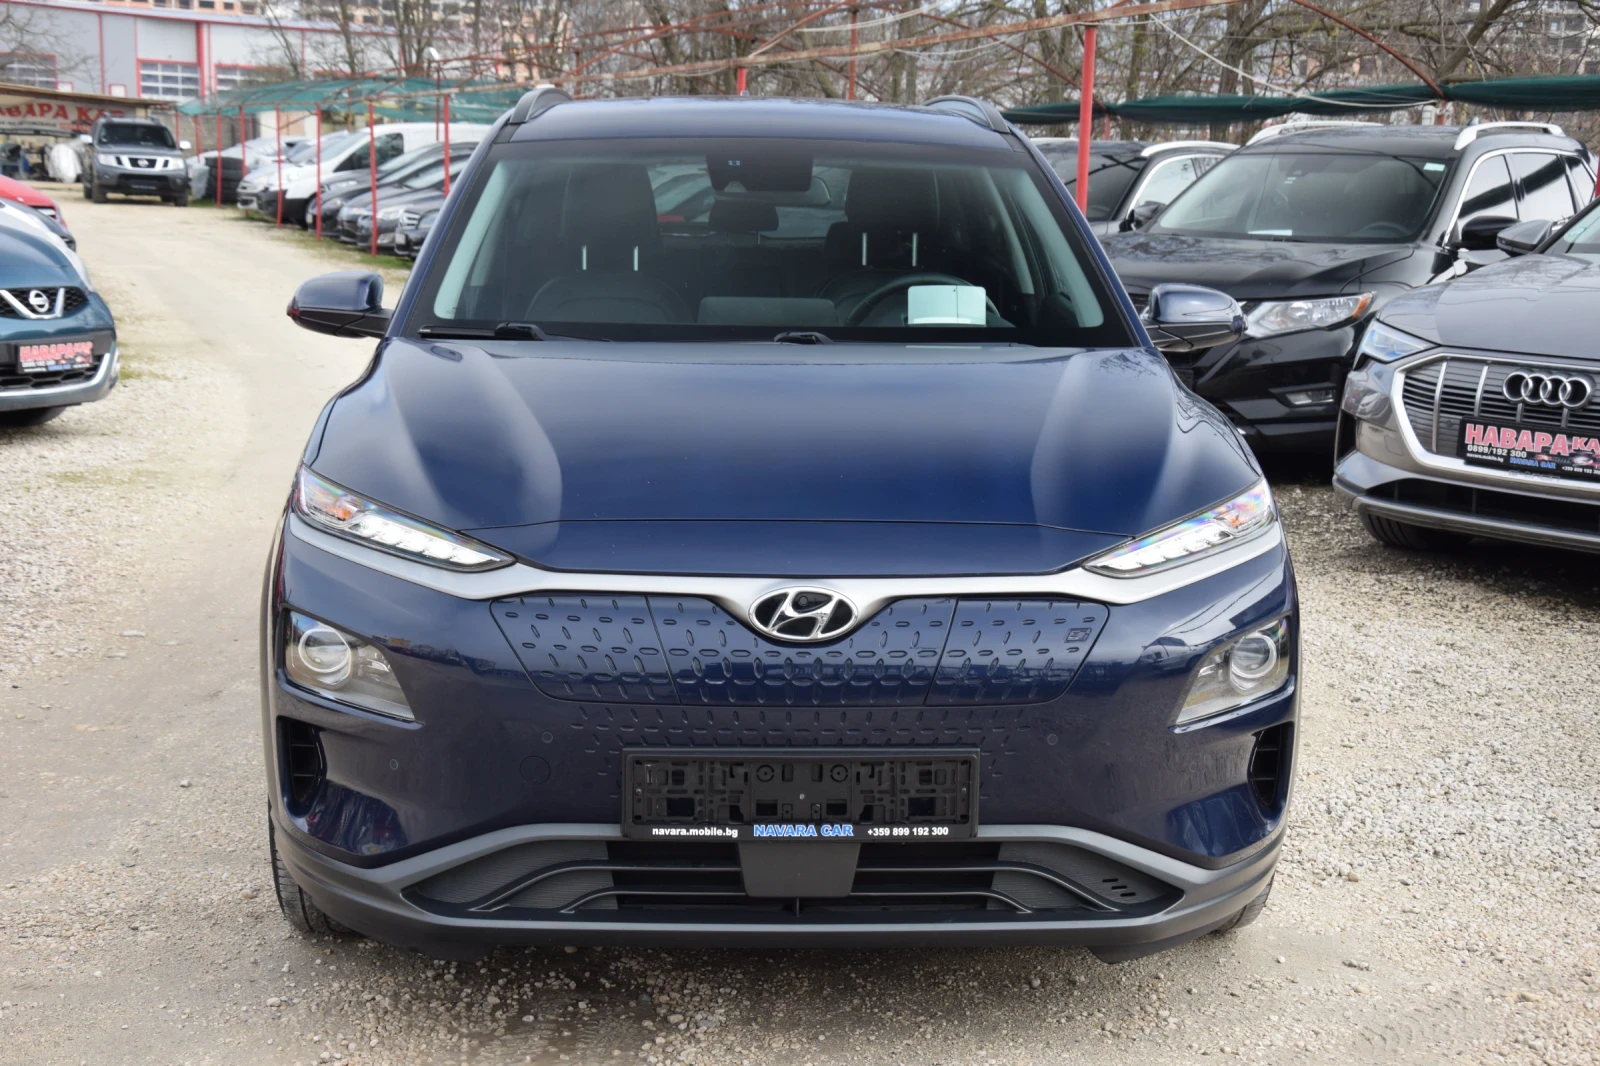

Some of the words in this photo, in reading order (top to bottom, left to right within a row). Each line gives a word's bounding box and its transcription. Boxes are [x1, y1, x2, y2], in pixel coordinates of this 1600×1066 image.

[1465, 423, 1569, 456] НАВАРА
[1571, 436, 1600, 453] КА
[1467, 444, 1507, 456] 0899/192
[1510, 449, 1527, 458] 300
[652, 827, 738, 838] navara.mobile.bg
[753, 824, 818, 837] NAVARA
[820, 824, 854, 837] CAR
[867, 827, 890, 836] +359
[892, 827, 910, 836] 899
[912, 827, 929, 836] 192
[931, 827, 949, 836] 300
